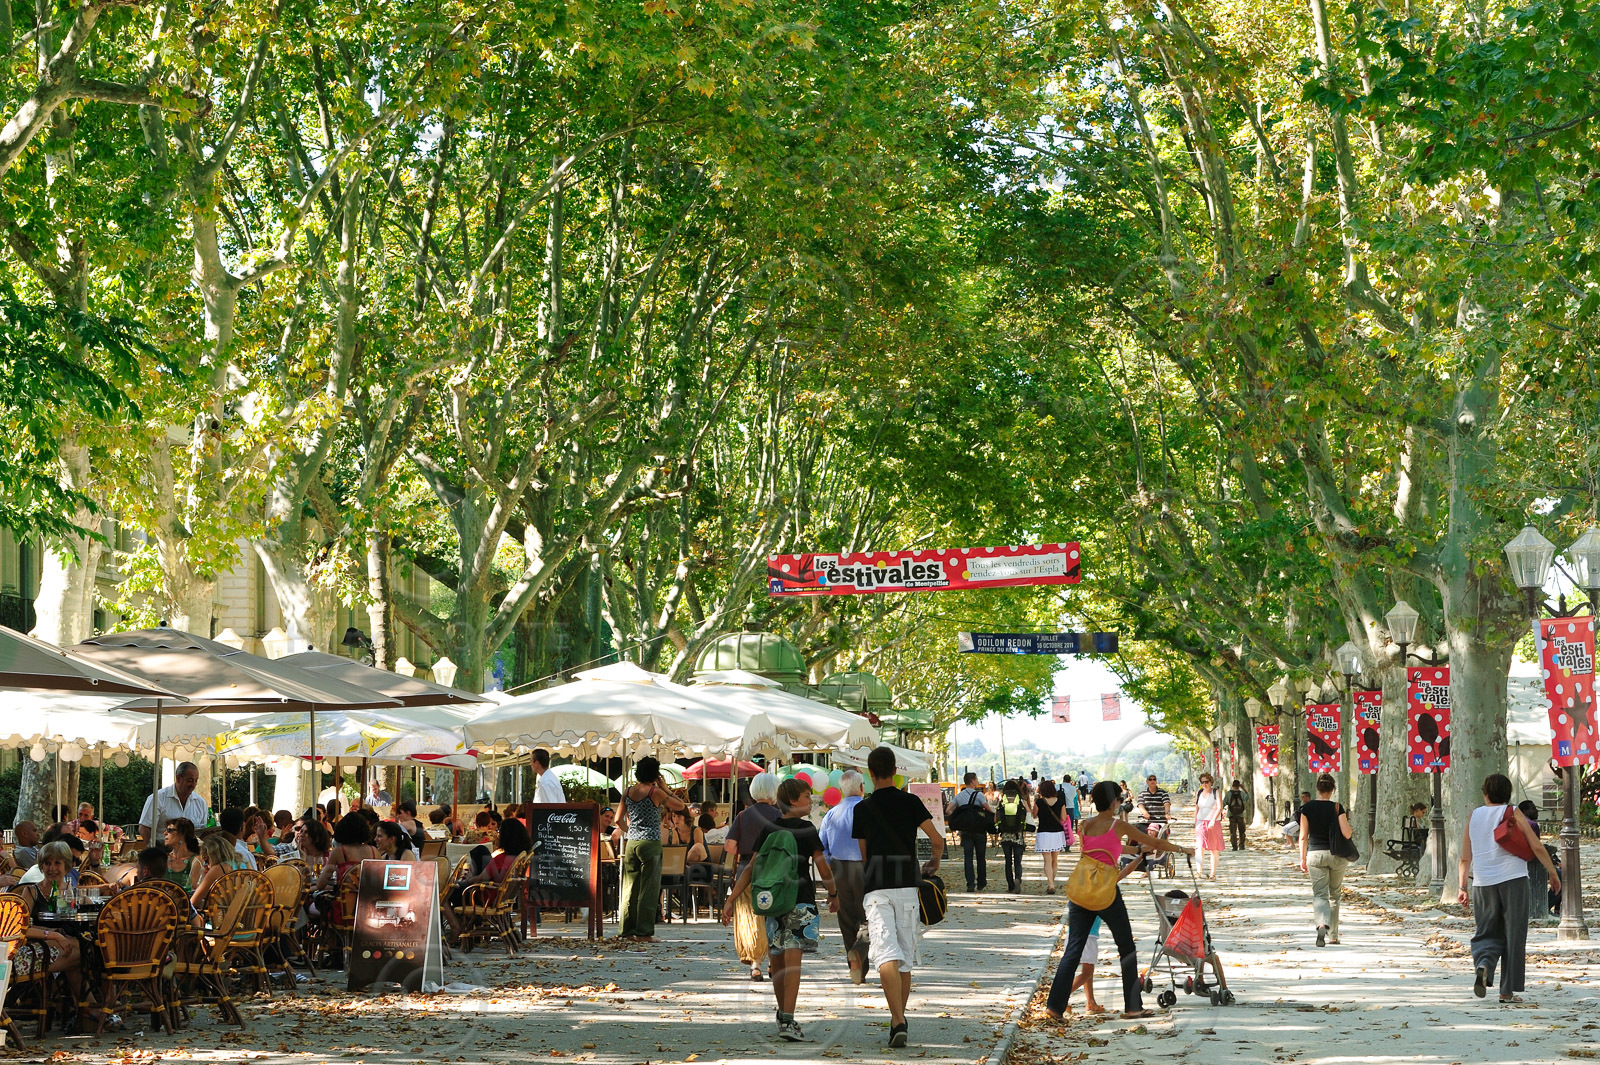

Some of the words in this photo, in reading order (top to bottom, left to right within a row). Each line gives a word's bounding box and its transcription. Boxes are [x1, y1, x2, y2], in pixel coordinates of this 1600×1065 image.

[815, 559, 836, 570] les
[970, 561, 989, 569] Tous
[991, 560, 1001, 568] les
[1003, 558, 1040, 567] vendredis
[827, 560, 940, 587] estivales
[970, 569, 1018, 578] rendez-vous
[1033, 565, 1059, 575] l'Espla
[914, 580, 949, 588] Montpellier
[977, 638, 1005, 647] ODILON
[1008, 638, 1032, 647] REDON
[1554, 638, 1565, 646] les
[1561, 643, 1584, 658] esti
[1558, 655, 1591, 669] vales
[1425, 686, 1448, 697] esti
[537, 823, 552, 834] Café
[383, 940, 419, 948] ARTISANALES
